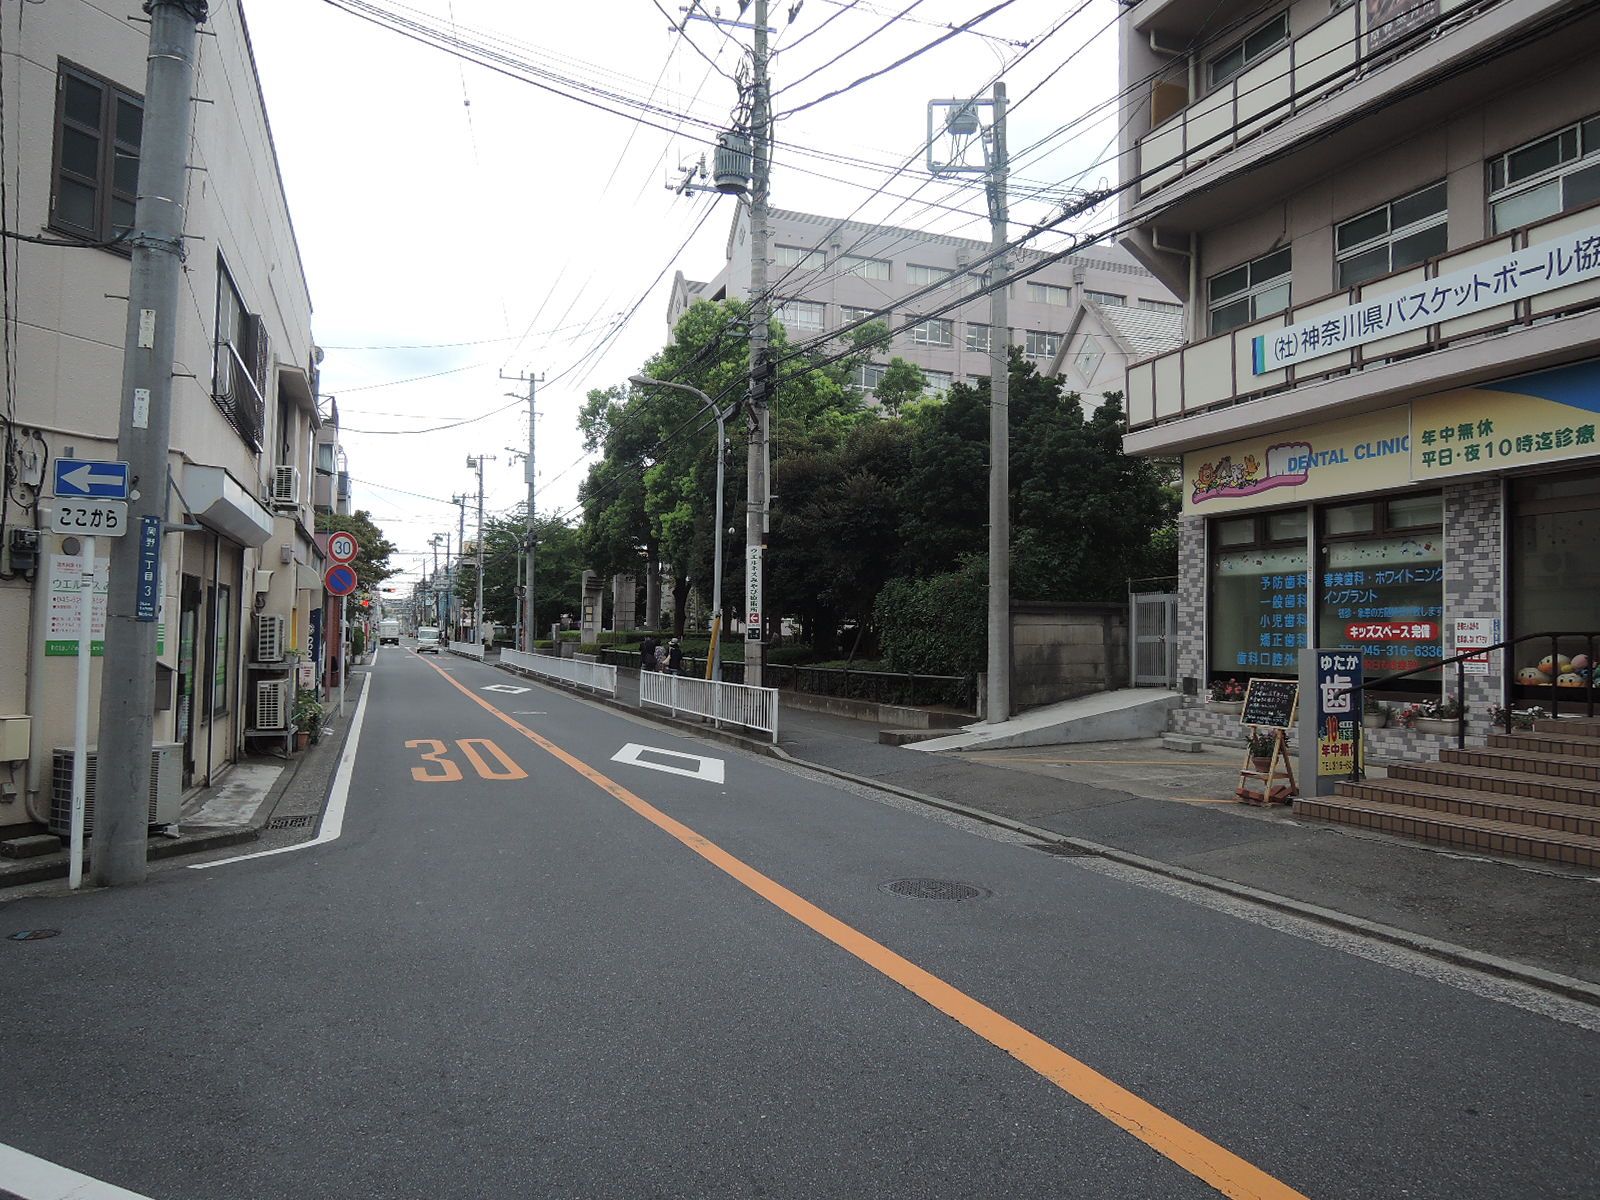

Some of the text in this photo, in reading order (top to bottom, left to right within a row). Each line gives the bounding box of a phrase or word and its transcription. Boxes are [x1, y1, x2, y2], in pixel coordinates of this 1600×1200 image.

[1421, 418, 1494, 447] 年中無休
[1287, 435, 1409, 472] DENTAL CLINIC
[60, 507, 118, 528] ここから
[334, 540, 351, 555] 30
[1260, 574, 1307, 590] 予防歯科
[1260, 592, 1307, 609] 一般歯科
[1323, 588, 1378, 604] インプラント
[1260, 612, 1307, 628] 小児歯科
[1260, 632, 1307, 647] 矯正歯科
[1350, 625, 1410, 638] キッズスペース
[1320, 655, 1359, 670] ゆたか
[1320, 673, 1353, 713] 歯
[405, 738, 529, 782] 30
